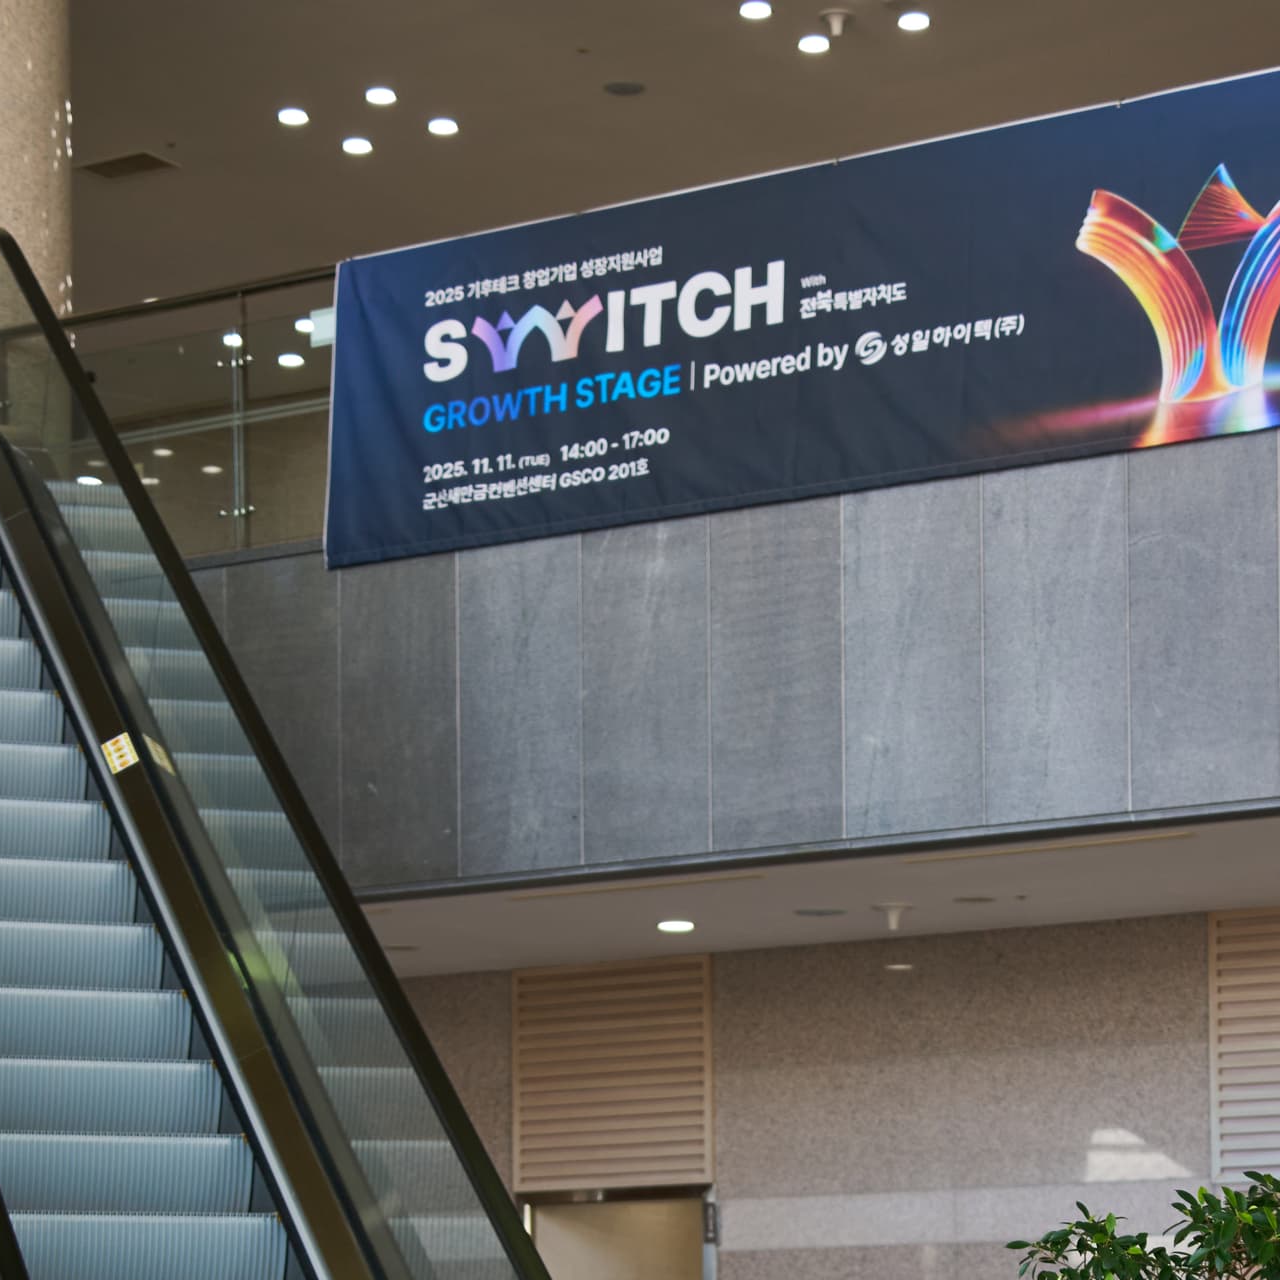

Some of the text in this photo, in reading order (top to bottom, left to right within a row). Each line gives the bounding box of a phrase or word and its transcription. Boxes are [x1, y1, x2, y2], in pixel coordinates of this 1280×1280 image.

[424, 246, 663, 308] 2025 기후테크 창업기업 성장지원사업
[800, 282, 907, 319] 전북특별자치도
[423, 260, 785, 383] SWITCH
[703, 346, 811, 389] Powered
[816, 343, 849, 371] by
[423, 363, 682, 434] GROWTH STAGE
[422, 457, 650, 511] 군산새만금컨벤션센터 GSCO 201호
[423, 460, 467, 484] 2025.
[517, 452, 551, 471] (TUE)
[559, 436, 609, 463] 14:00
[622, 427, 670, 451] 17:00
